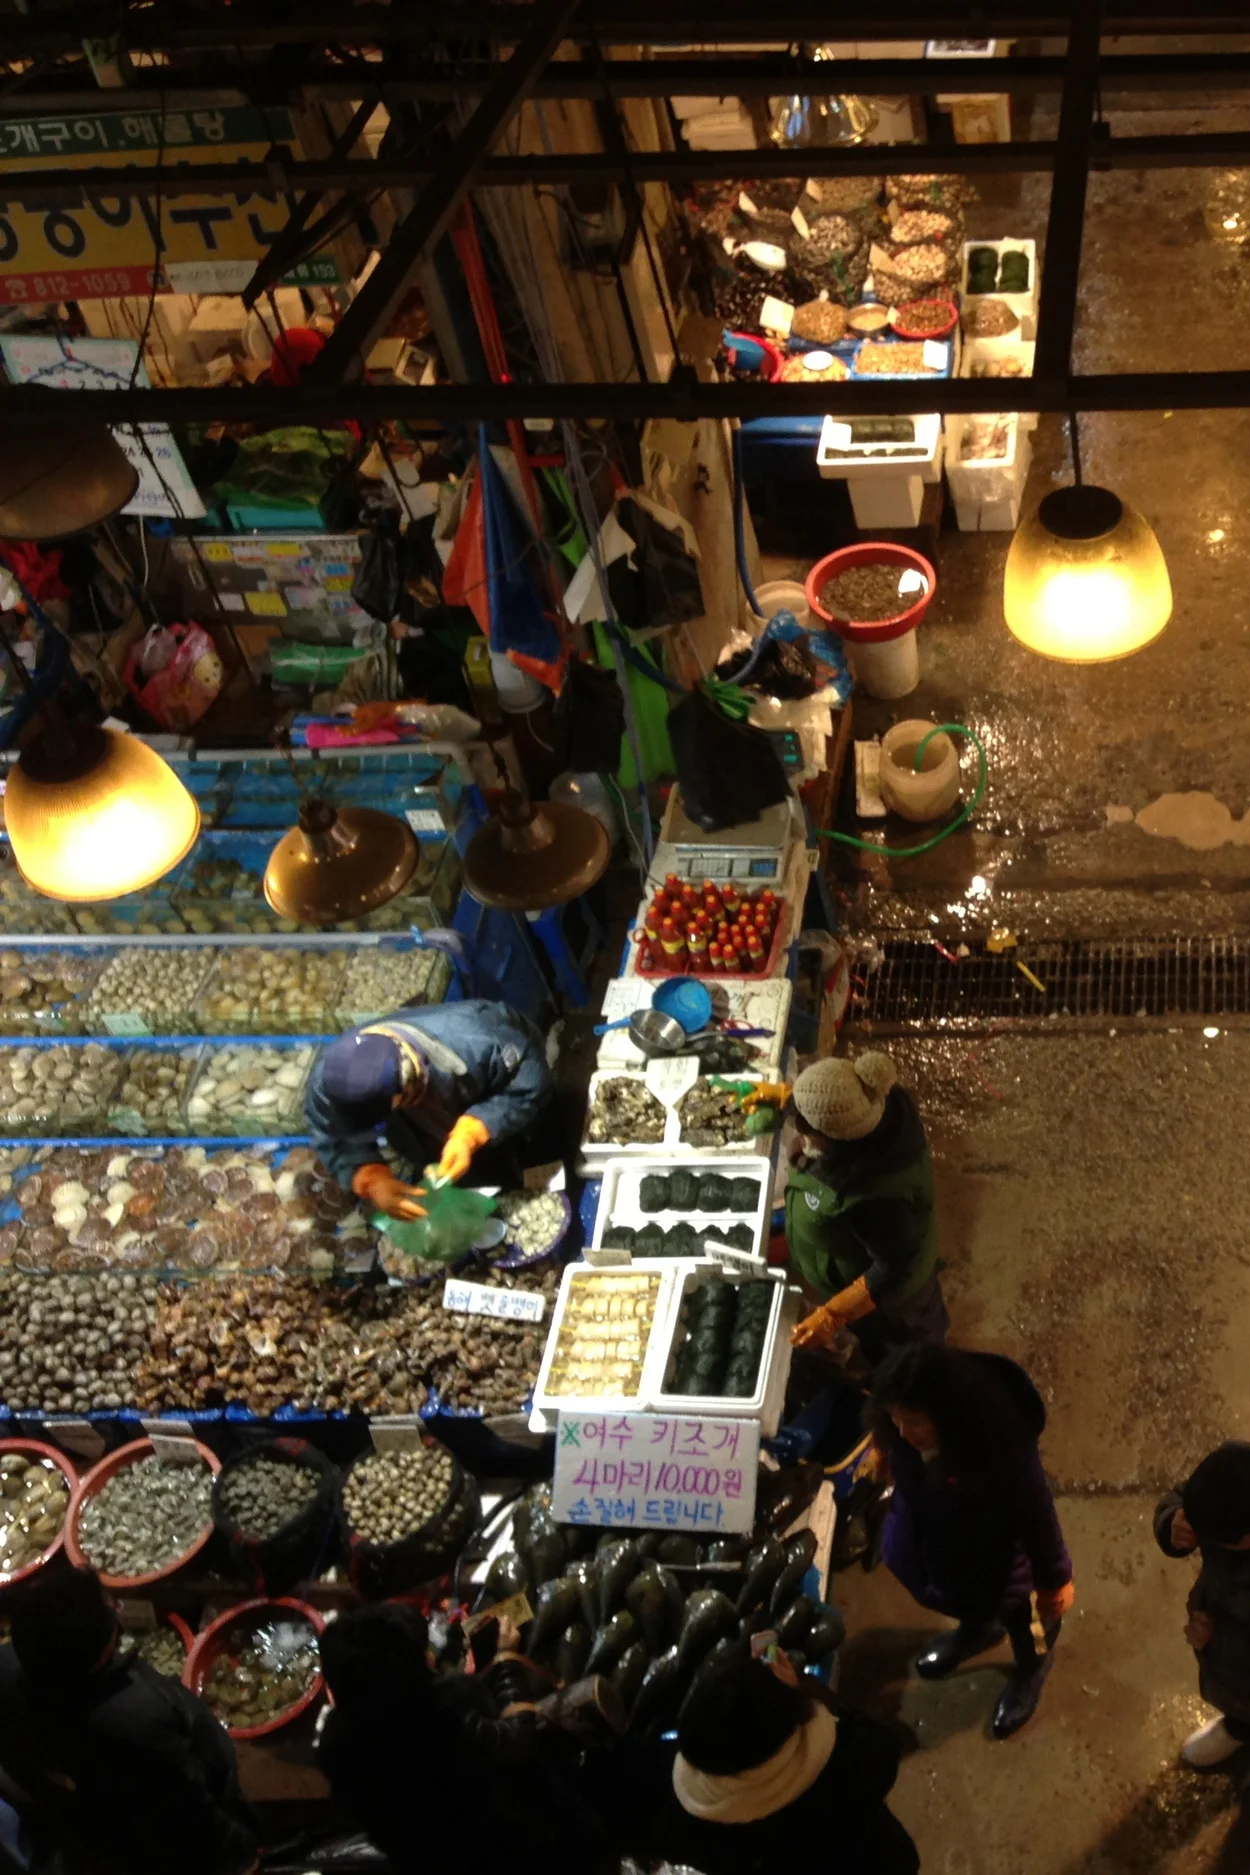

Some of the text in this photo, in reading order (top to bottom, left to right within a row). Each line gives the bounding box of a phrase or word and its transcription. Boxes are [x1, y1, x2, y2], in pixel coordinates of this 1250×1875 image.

[33, 272, 131, 297] 812-1059
[650, 1419, 740, 1460] 키조개
[567, 1497, 635, 1524] 손질해
